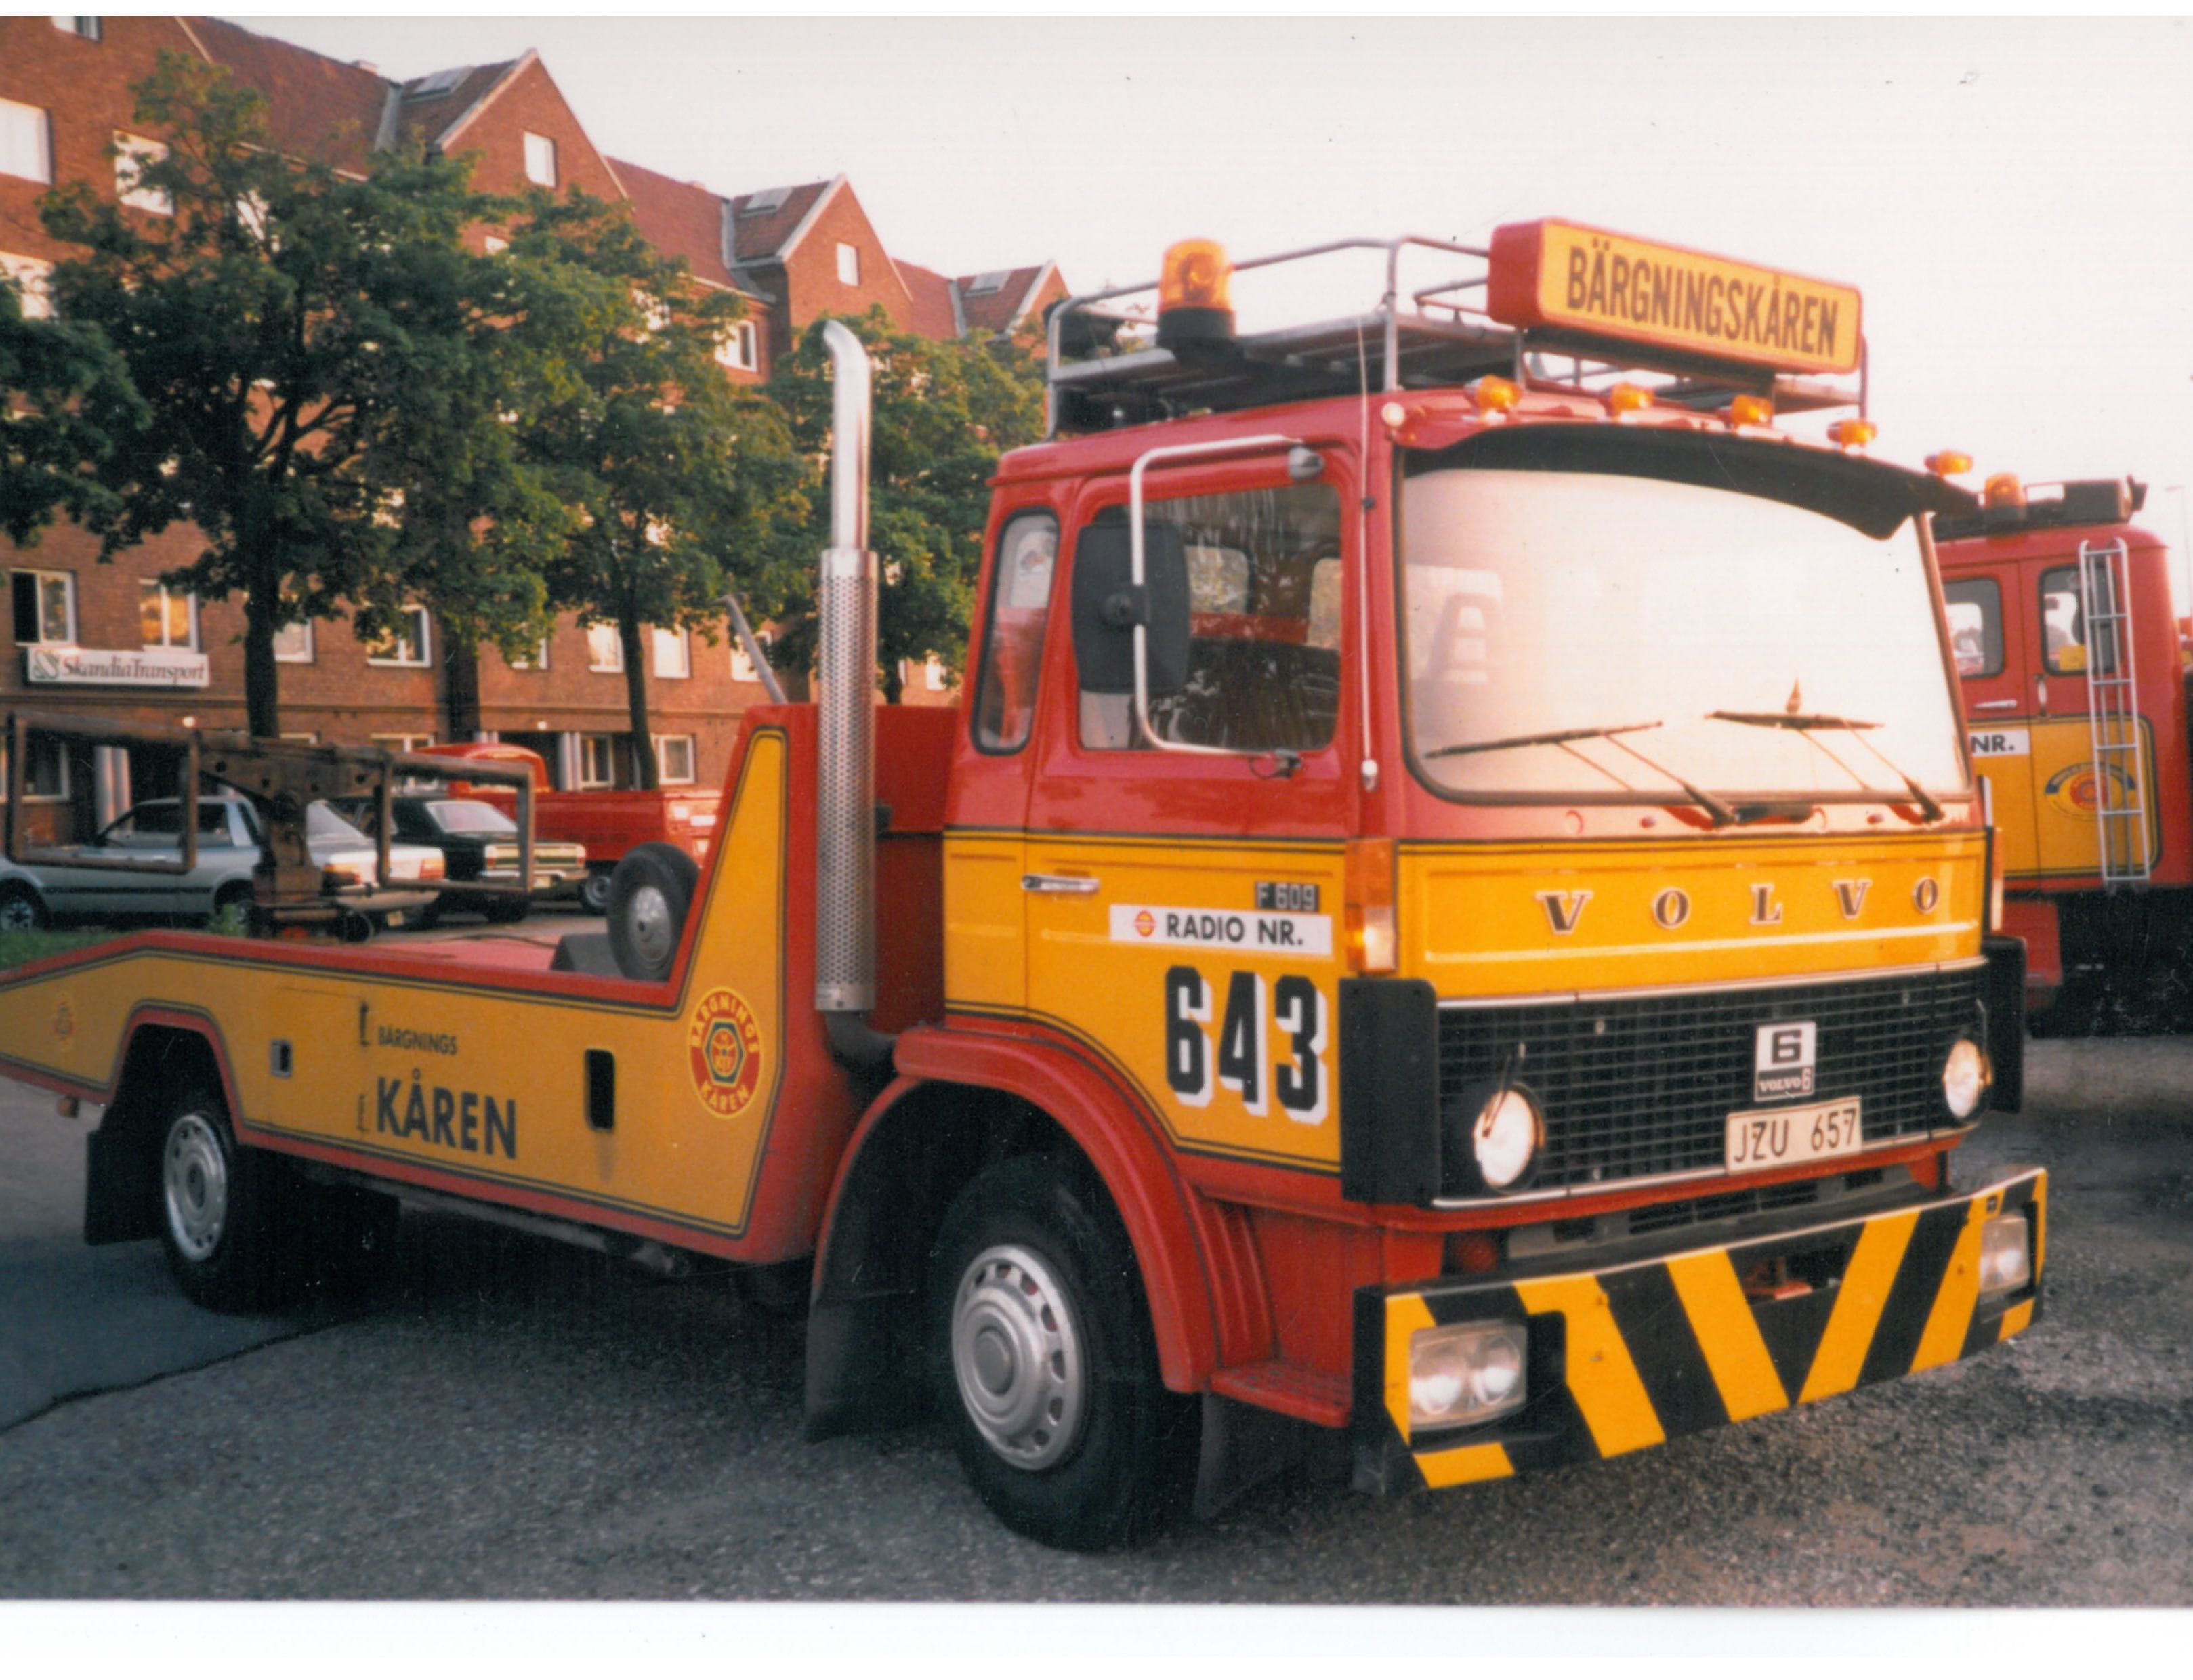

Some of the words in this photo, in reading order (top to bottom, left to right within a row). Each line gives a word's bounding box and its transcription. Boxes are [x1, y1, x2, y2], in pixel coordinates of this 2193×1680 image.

[1566, 237, 1839, 358] BÄRGNINGSKÅREN
[1971, 734, 2015, 753] NR.
[1257, 882, 1269, 908] F
[1275, 883, 1316, 911] 609
[1535, 876, 1940, 936] VOLVO
[1166, 913, 1245, 942] RADIO
[1257, 919, 1303, 946] NR.
[1165, 965, 1329, 1125] 643
[1772, 1029, 1803, 1065] 6
[377, 1067, 517, 1160] KÅREN
[1734, 1119, 1790, 1163] JZU
[1810, 1107, 1857, 1152] 657
